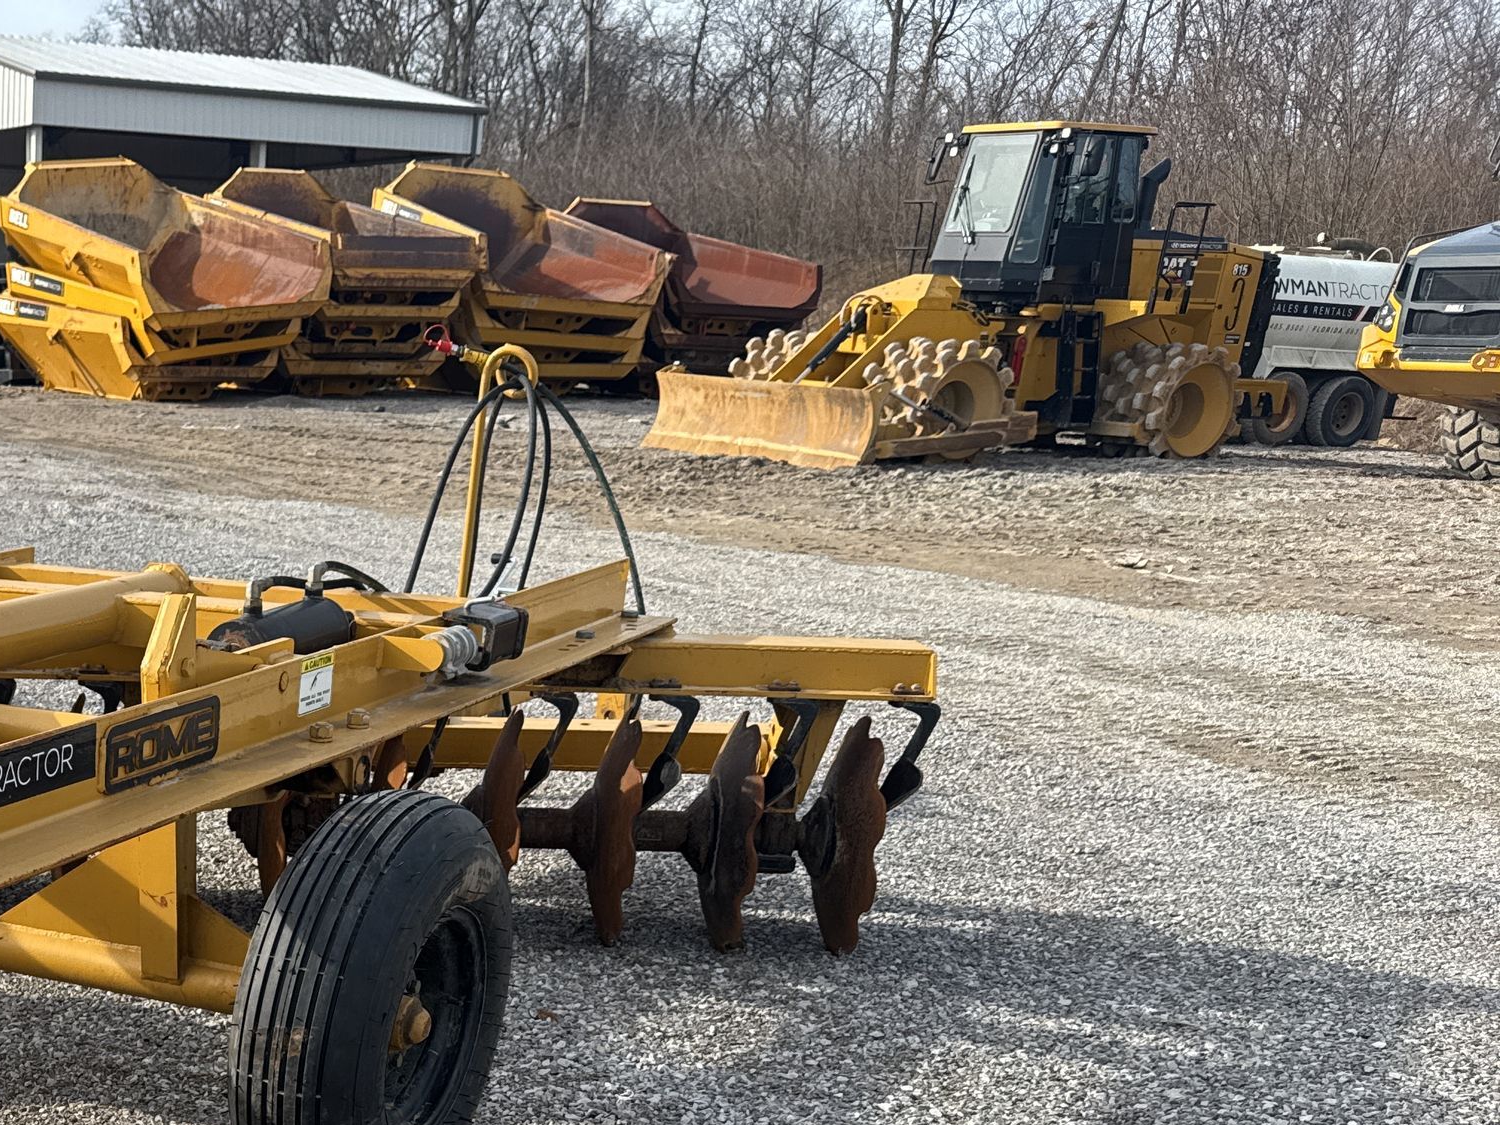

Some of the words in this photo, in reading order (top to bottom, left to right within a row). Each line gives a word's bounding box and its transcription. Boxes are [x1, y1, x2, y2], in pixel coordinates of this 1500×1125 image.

[1232, 263, 1248, 276] 815
[1277, 278, 1390, 301] WMANTRACTO
[1312, 305, 1353, 318] RENTALS
[112, 709, 214, 774] ROME
